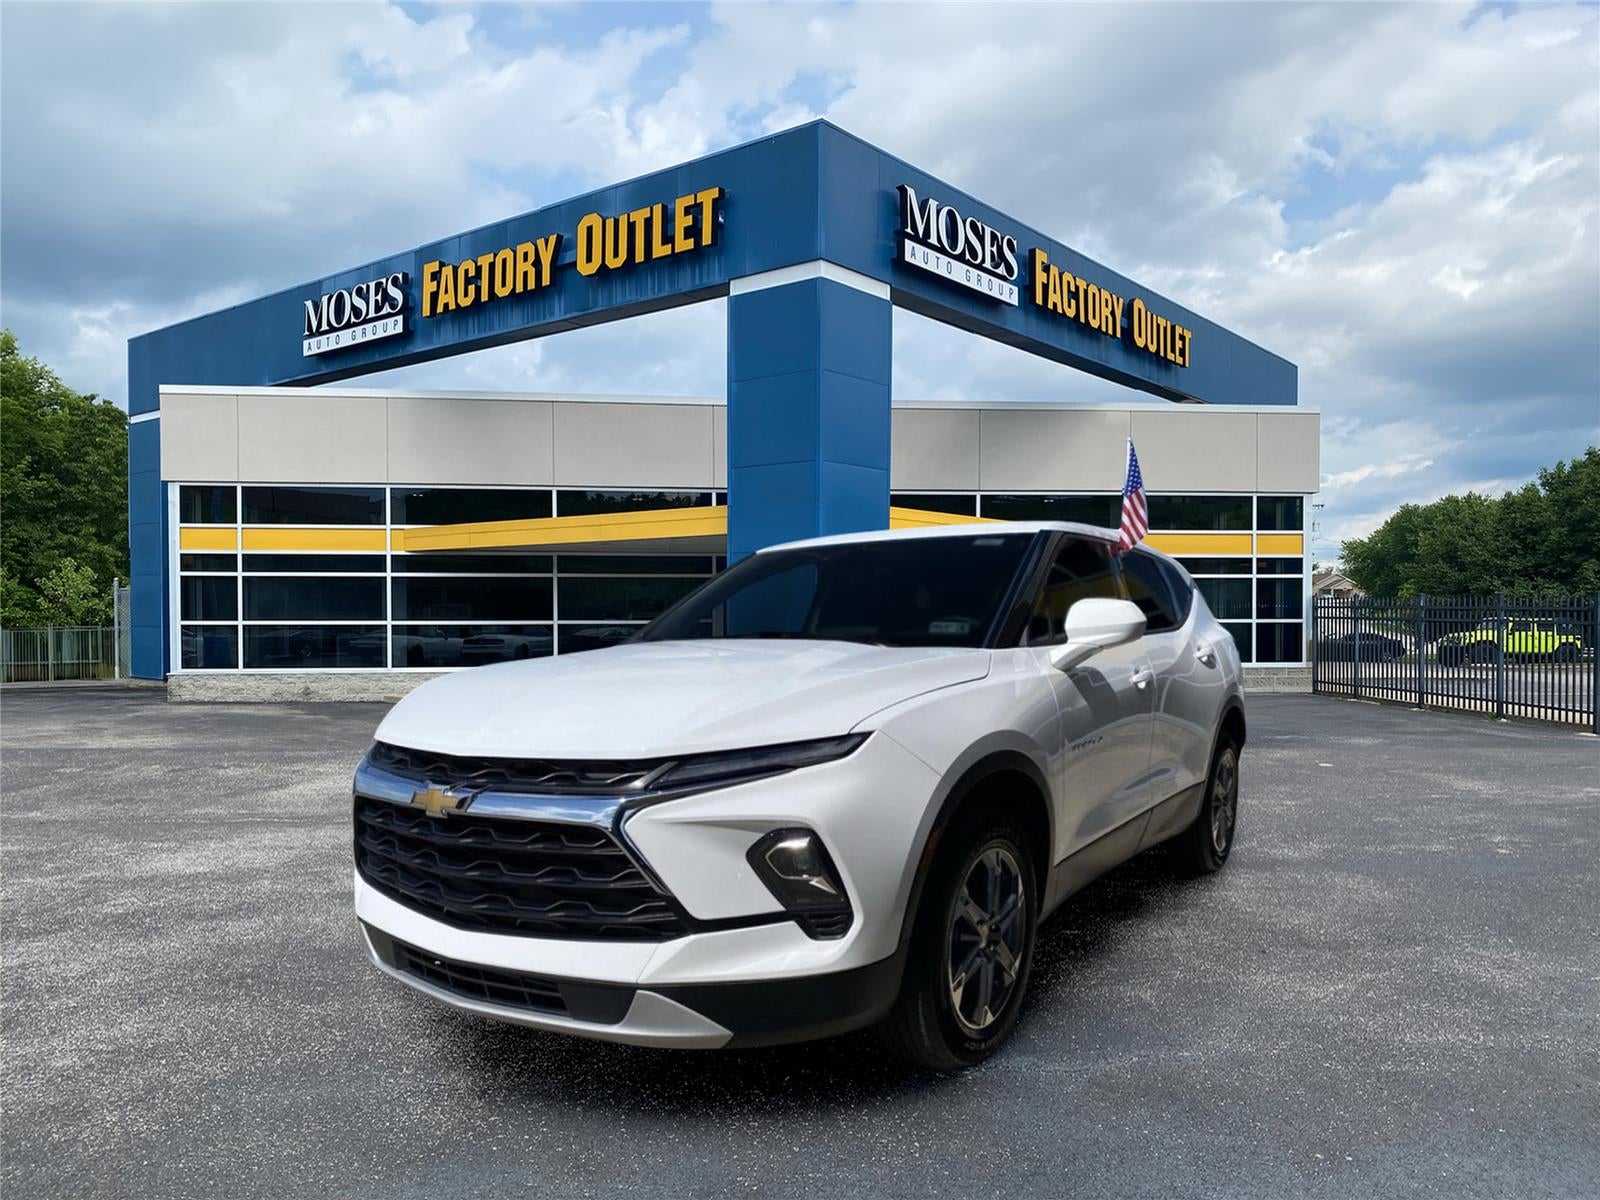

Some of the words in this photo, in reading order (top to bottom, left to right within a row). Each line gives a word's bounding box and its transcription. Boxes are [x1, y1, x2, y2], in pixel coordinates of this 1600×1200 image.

[422, 232, 560, 318] FACTORY
[576, 186, 721, 277] OUTLET
[903, 184, 1019, 280] MOSES
[910, 245, 953, 275] AUTO
[965, 269, 1015, 299] GROUP
[303, 272, 404, 337] MOSES
[307, 334, 341, 352] AUTO
[351, 319, 399, 341] GROUP
[1035, 247, 1124, 338] FACTORY
[1133, 297, 1192, 368] OUTLET
